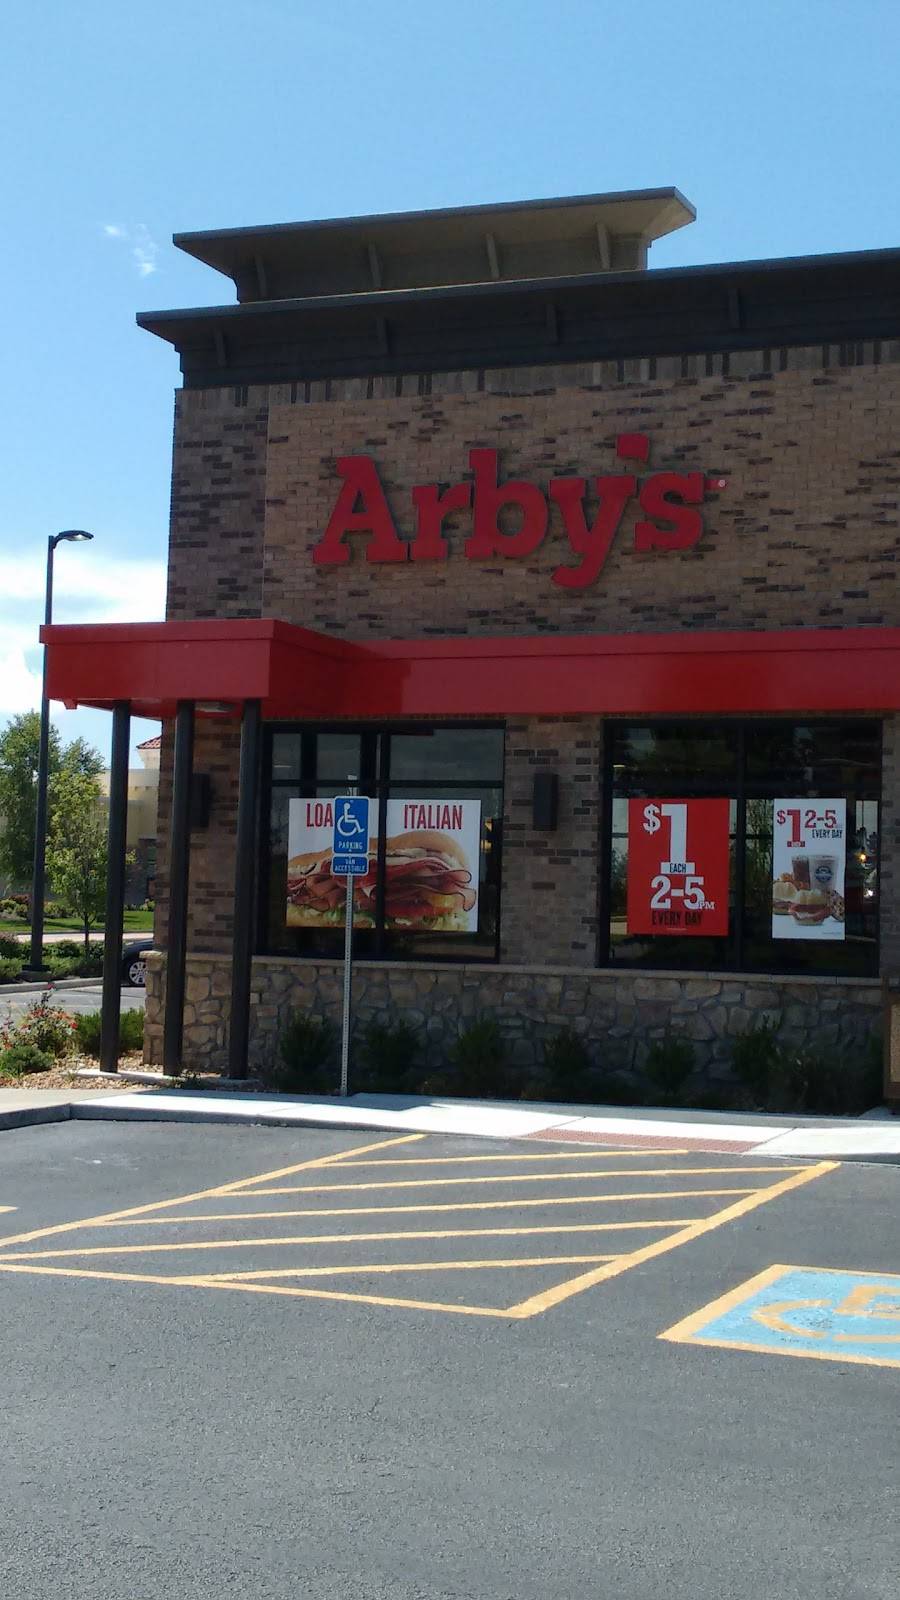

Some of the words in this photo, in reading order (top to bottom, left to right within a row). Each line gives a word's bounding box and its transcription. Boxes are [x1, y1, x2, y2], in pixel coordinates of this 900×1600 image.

[312, 433, 706, 588] Arby's
[306, 803, 334, 827] LOA
[403, 805, 463, 829] ITALIAN
[811, 829, 830, 839] EVERY
[831, 829, 843, 839] DAY
[338, 841, 363, 850] PARKING
[669, 863, 687, 873] EACH
[652, 911, 681, 926] EVERY
[685, 911, 703, 926] DAY
